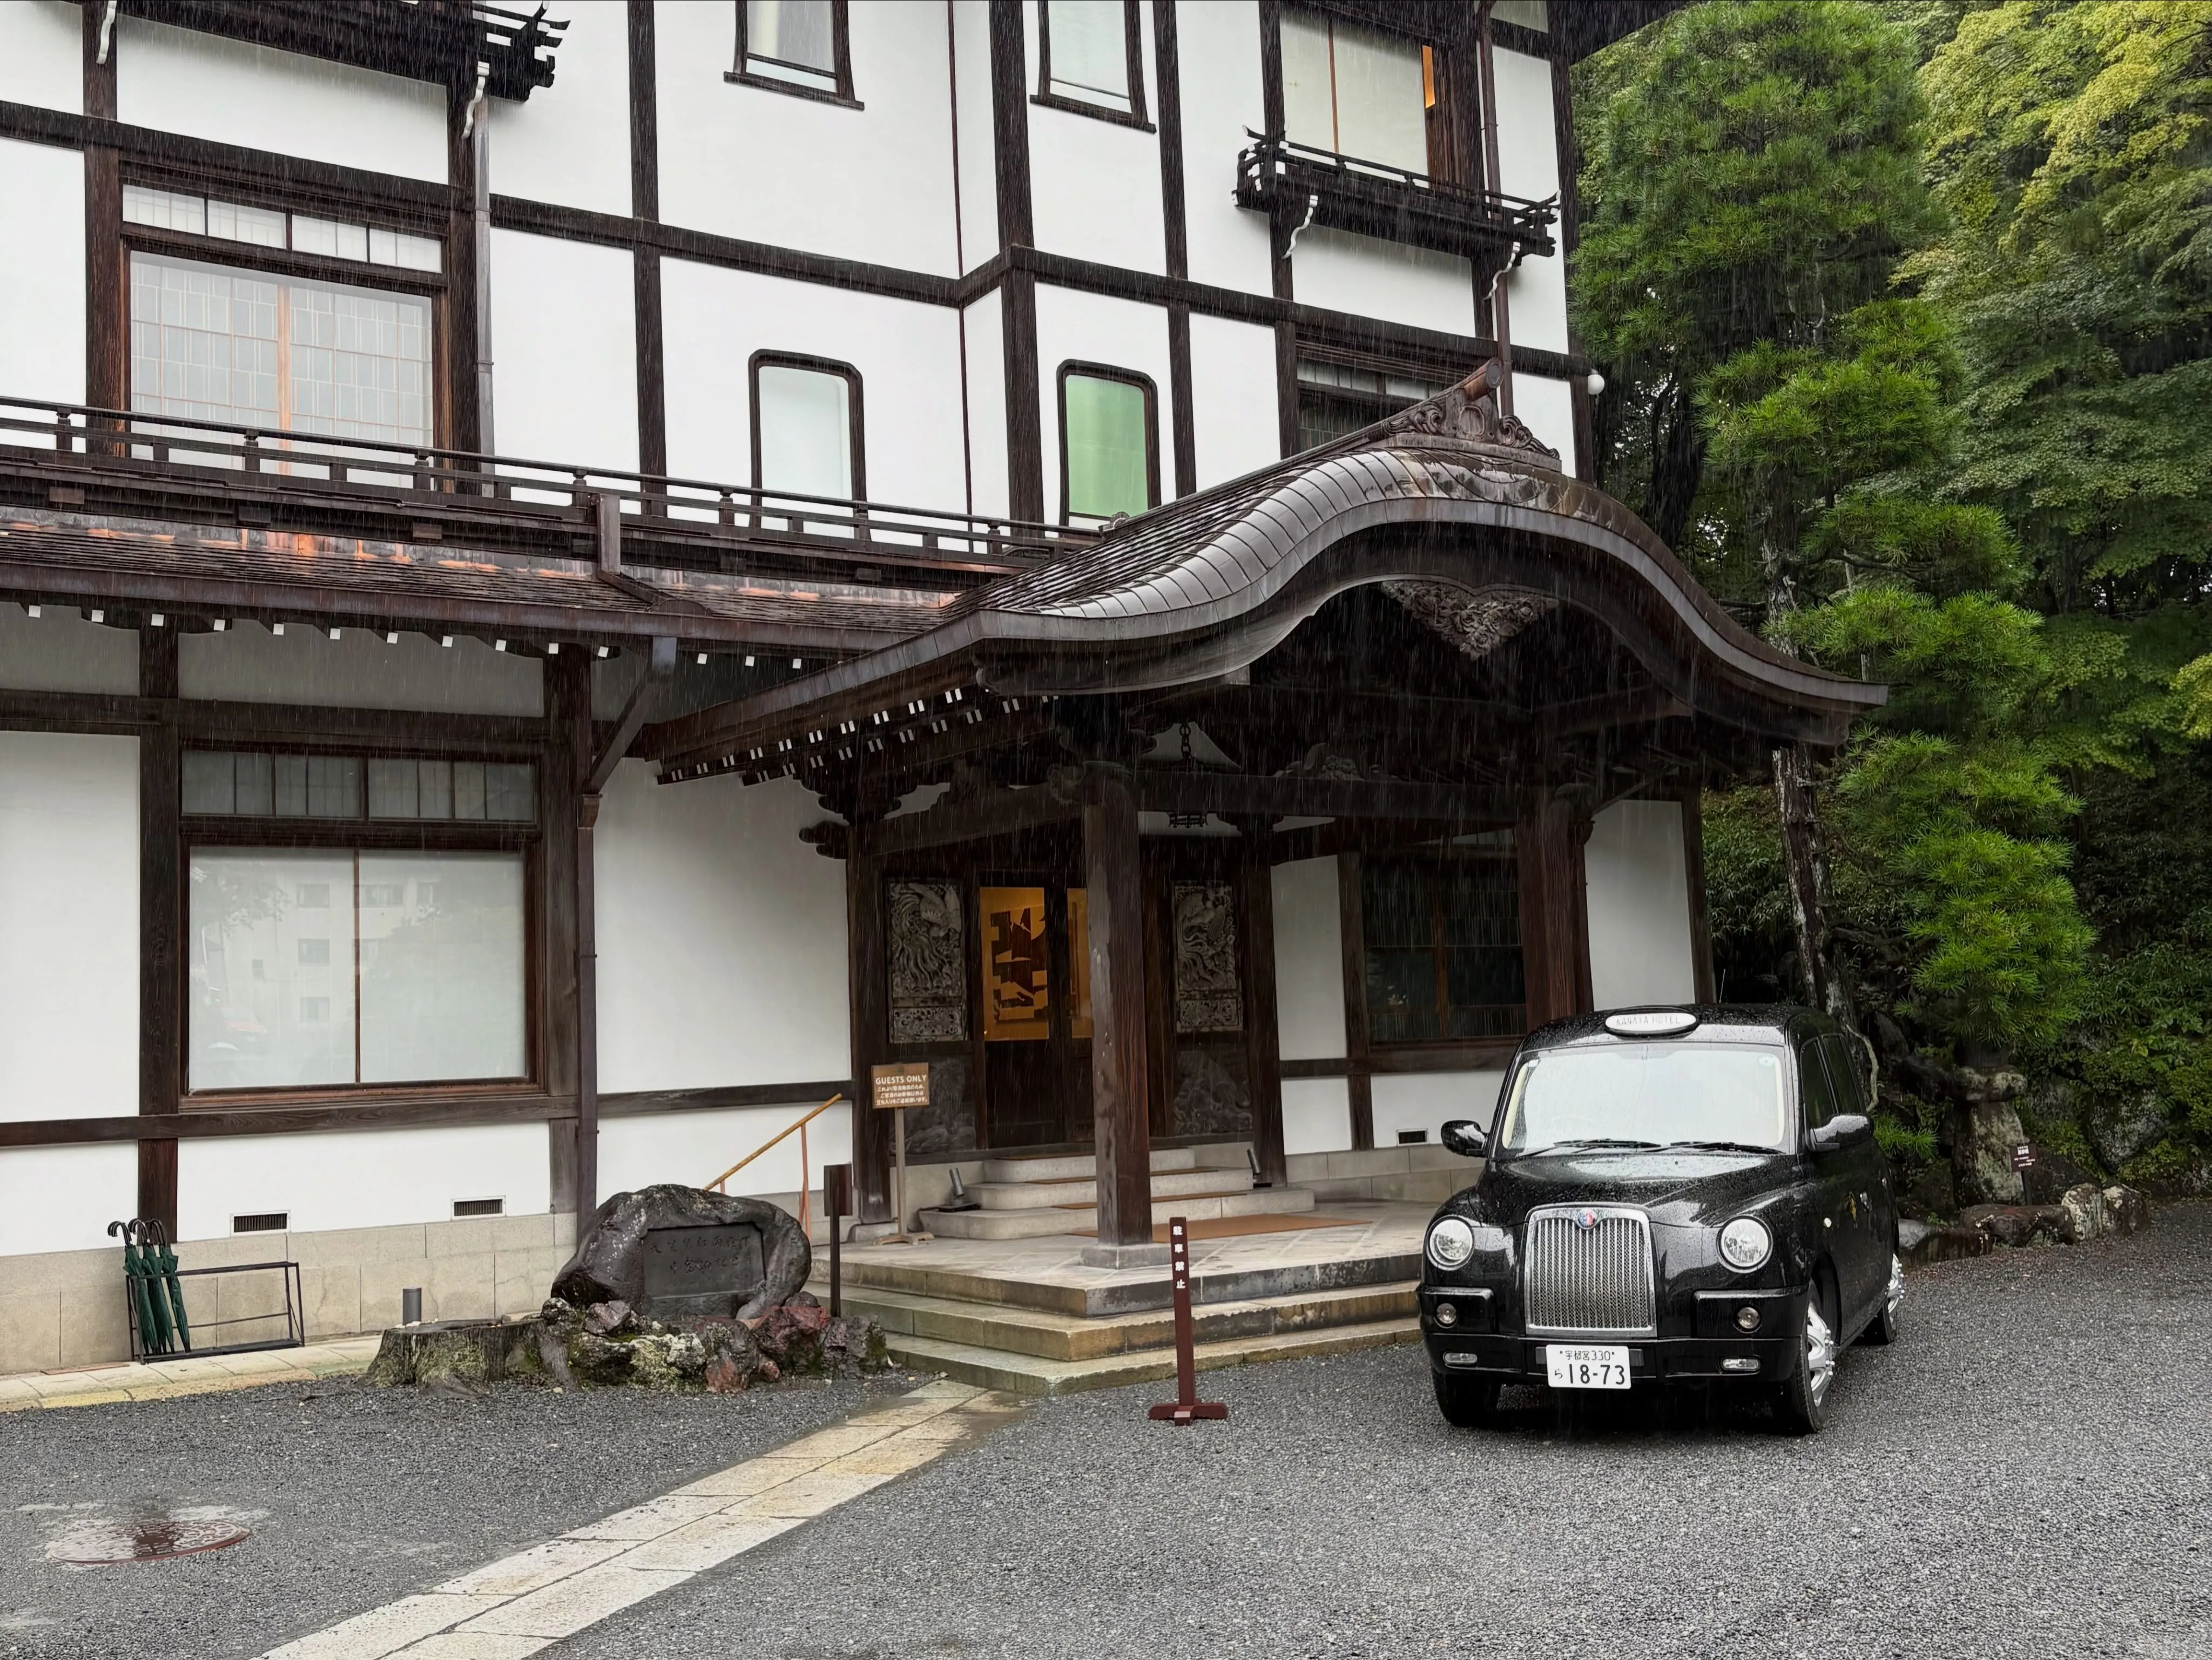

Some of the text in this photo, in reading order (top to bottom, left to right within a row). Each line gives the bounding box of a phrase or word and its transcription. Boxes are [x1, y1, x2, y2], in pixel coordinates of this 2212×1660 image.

[1616, 1016, 1649, 1025] KANAYA
[875, 1074, 927, 1085] GUESTS ONLY
[1554, 1364, 1625, 1385] ら 18-73
